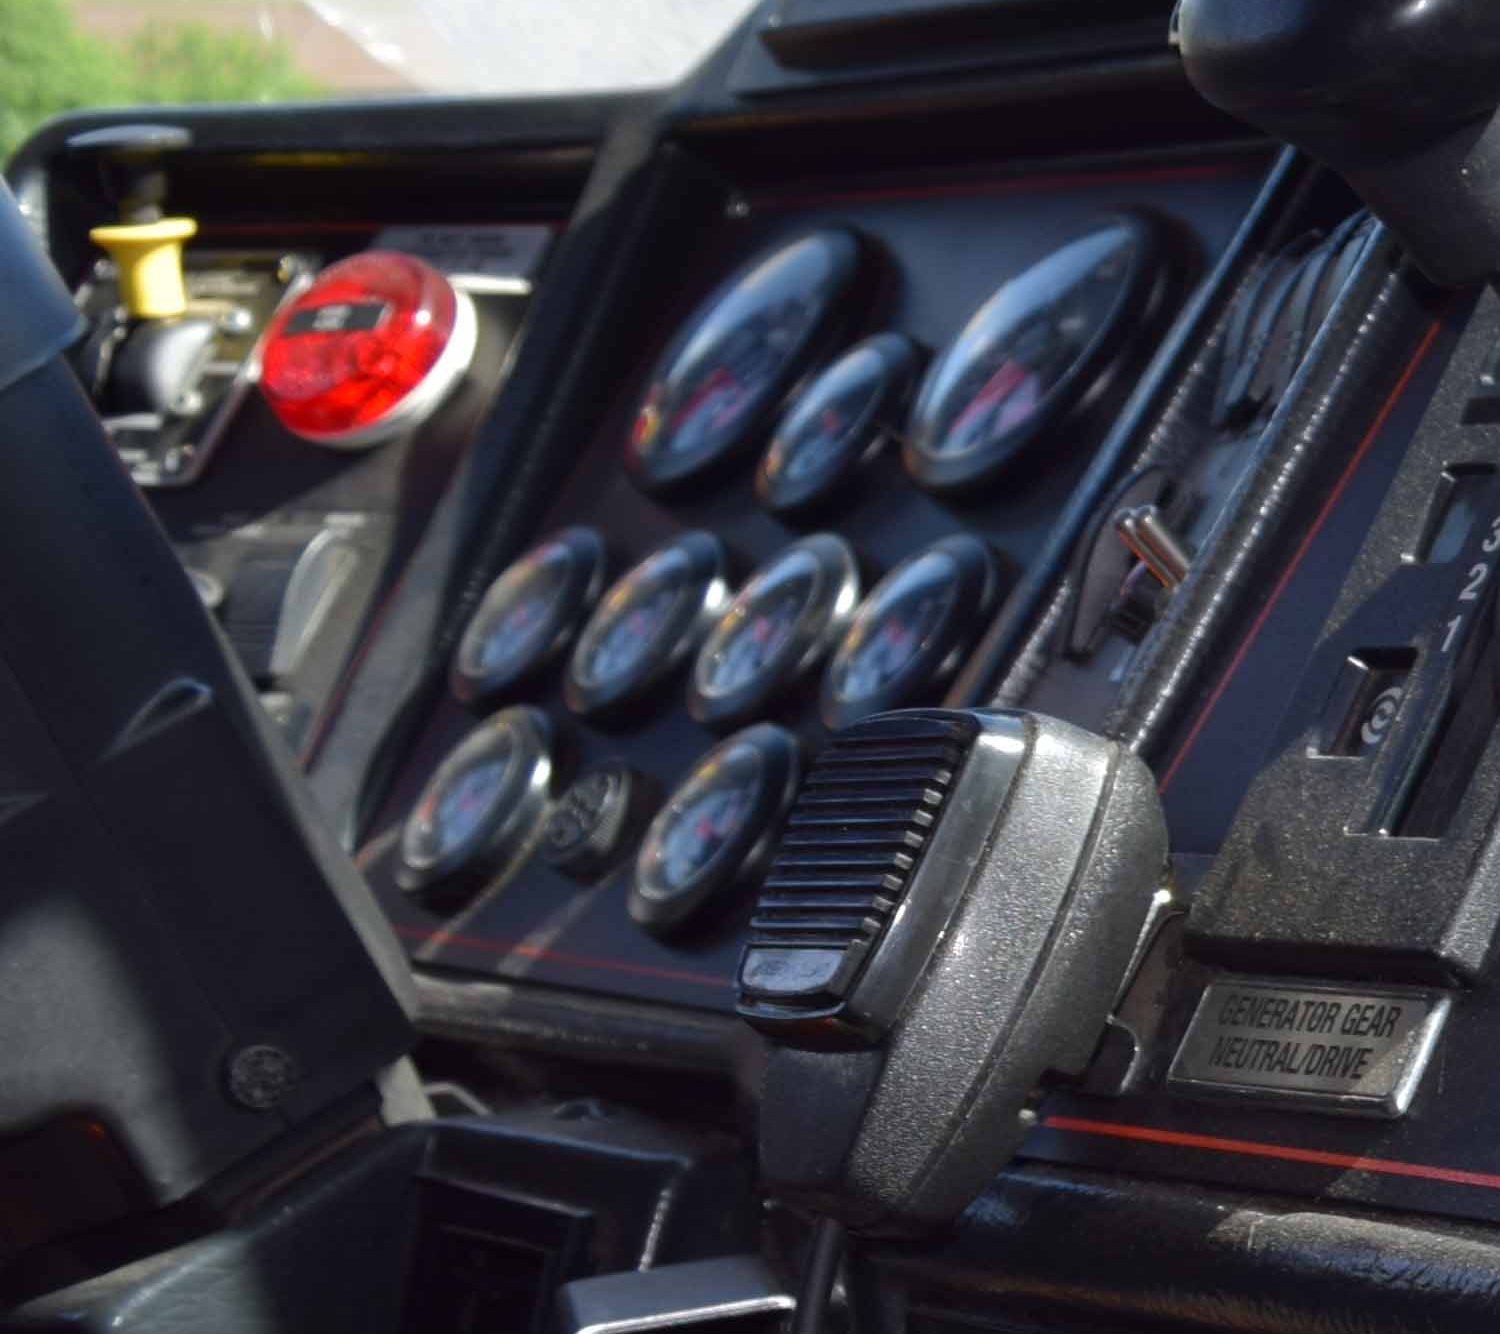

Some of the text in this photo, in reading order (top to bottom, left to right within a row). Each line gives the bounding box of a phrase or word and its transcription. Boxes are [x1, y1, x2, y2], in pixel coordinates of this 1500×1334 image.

[1458, 563, 1488, 600] 2
[1440, 614, 1463, 652] 1
[1218, 993, 1402, 1038] GENERATOR GEAR
[1208, 1034, 1374, 1080] NEUTRAL/DRIVE
